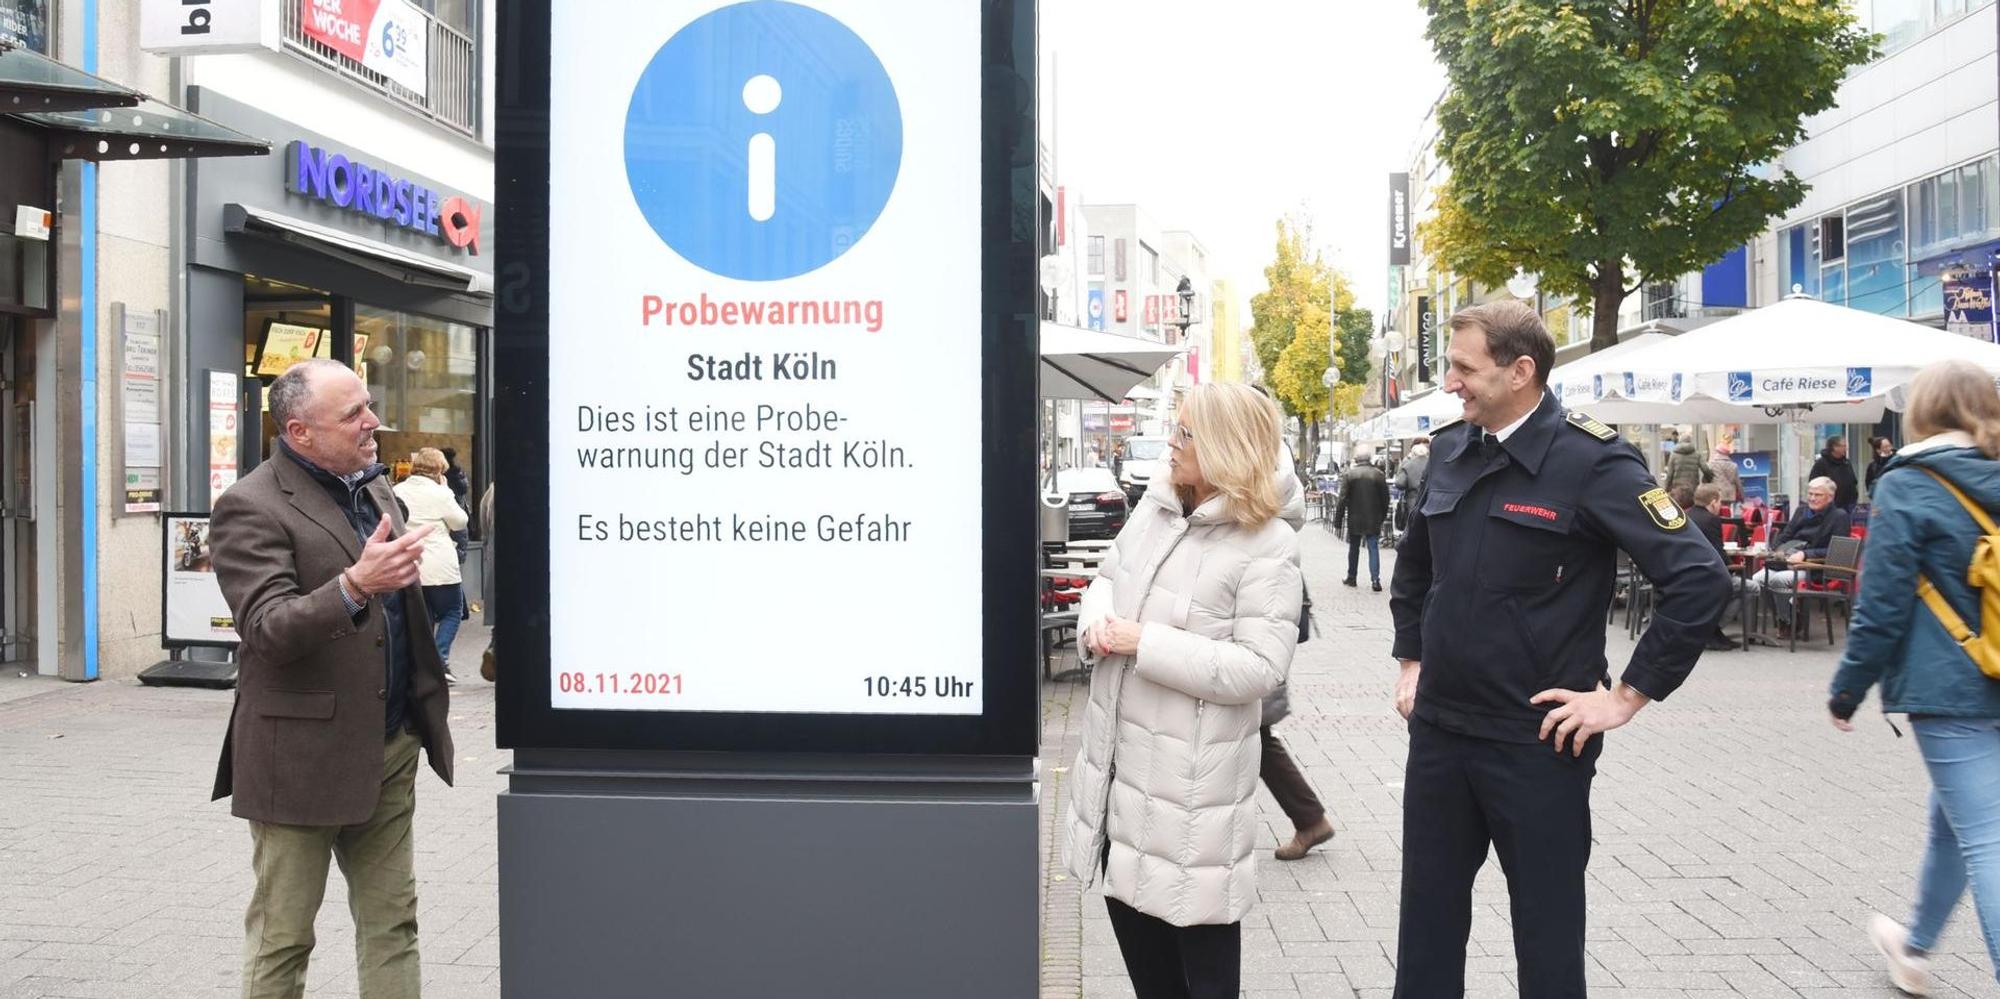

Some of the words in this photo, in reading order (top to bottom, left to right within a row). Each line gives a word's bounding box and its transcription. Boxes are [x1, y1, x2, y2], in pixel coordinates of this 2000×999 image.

[313, 8, 361, 46] WOCHE
[290, 140, 439, 236] NORDSEE
[1393, 189, 1406, 248] Kraemer
[642, 293, 883, 332] Probewarnung
[687, 352, 763, 381] Stadt
[773, 352, 837, 380] Köln
[1762, 379, 1793, 391] Café
[1798, 376, 1837, 390] Riese
[579, 405, 635, 432] Dies
[647, 405, 678, 432] ist
[689, 405, 745, 431] eine
[758, 403, 848, 432] Probe-
[577, 448, 693, 475] warnung
[705, 440, 748, 468] der
[759, 440, 832, 468] Stadt
[844, 440, 913, 468] Köln.
[1503, 503, 1557, 520] FEUERWEHR
[579, 514, 608, 541] Es
[620, 513, 721, 541] besteht
[733, 513, 806, 541] keine
[817, 513, 911, 542] Gefahr
[560, 672, 682, 694] 08.11.2021
[864, 676, 926, 697] 10:45
[936, 676, 974, 697] Uhr
